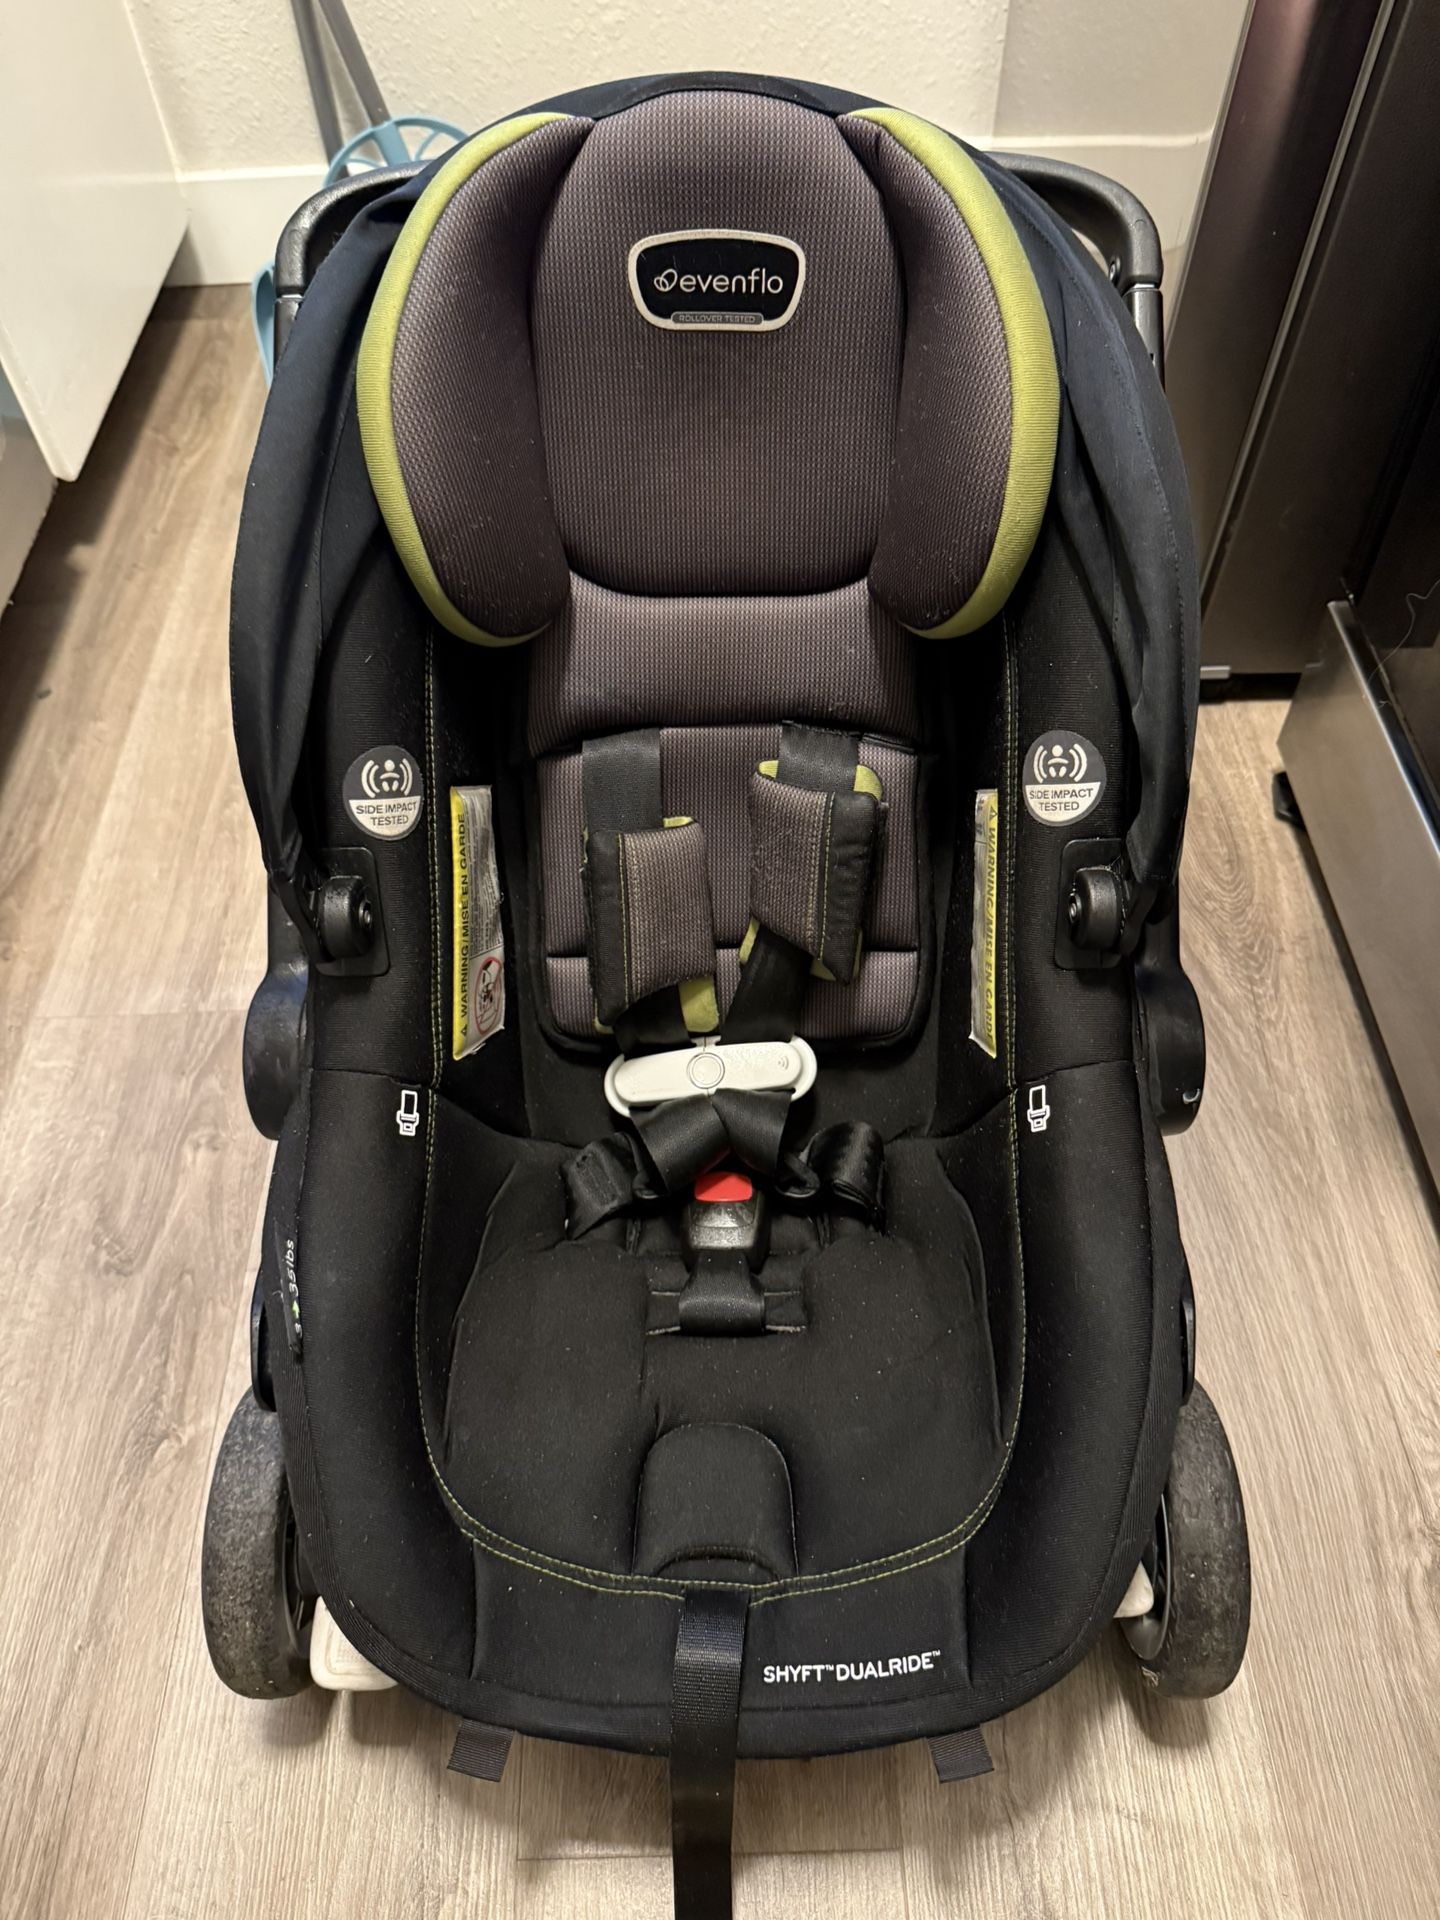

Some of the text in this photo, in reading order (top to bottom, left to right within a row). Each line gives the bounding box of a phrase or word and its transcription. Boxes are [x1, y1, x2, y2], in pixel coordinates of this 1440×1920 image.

[679, 267, 783, 294] evenflo
[679, 314, 756, 323] ROLLOVER TESTED
[1029, 788, 1094, 800] SIDE IMPACT
[355, 802, 417, 815] SIDE IMPACT
[1038, 801, 1080, 812] TESTED
[370, 815, 409, 826] TESTED
[458, 813, 468, 870] GARDE
[461, 875, 469, 900] EN
[985, 962, 993, 983] EN
